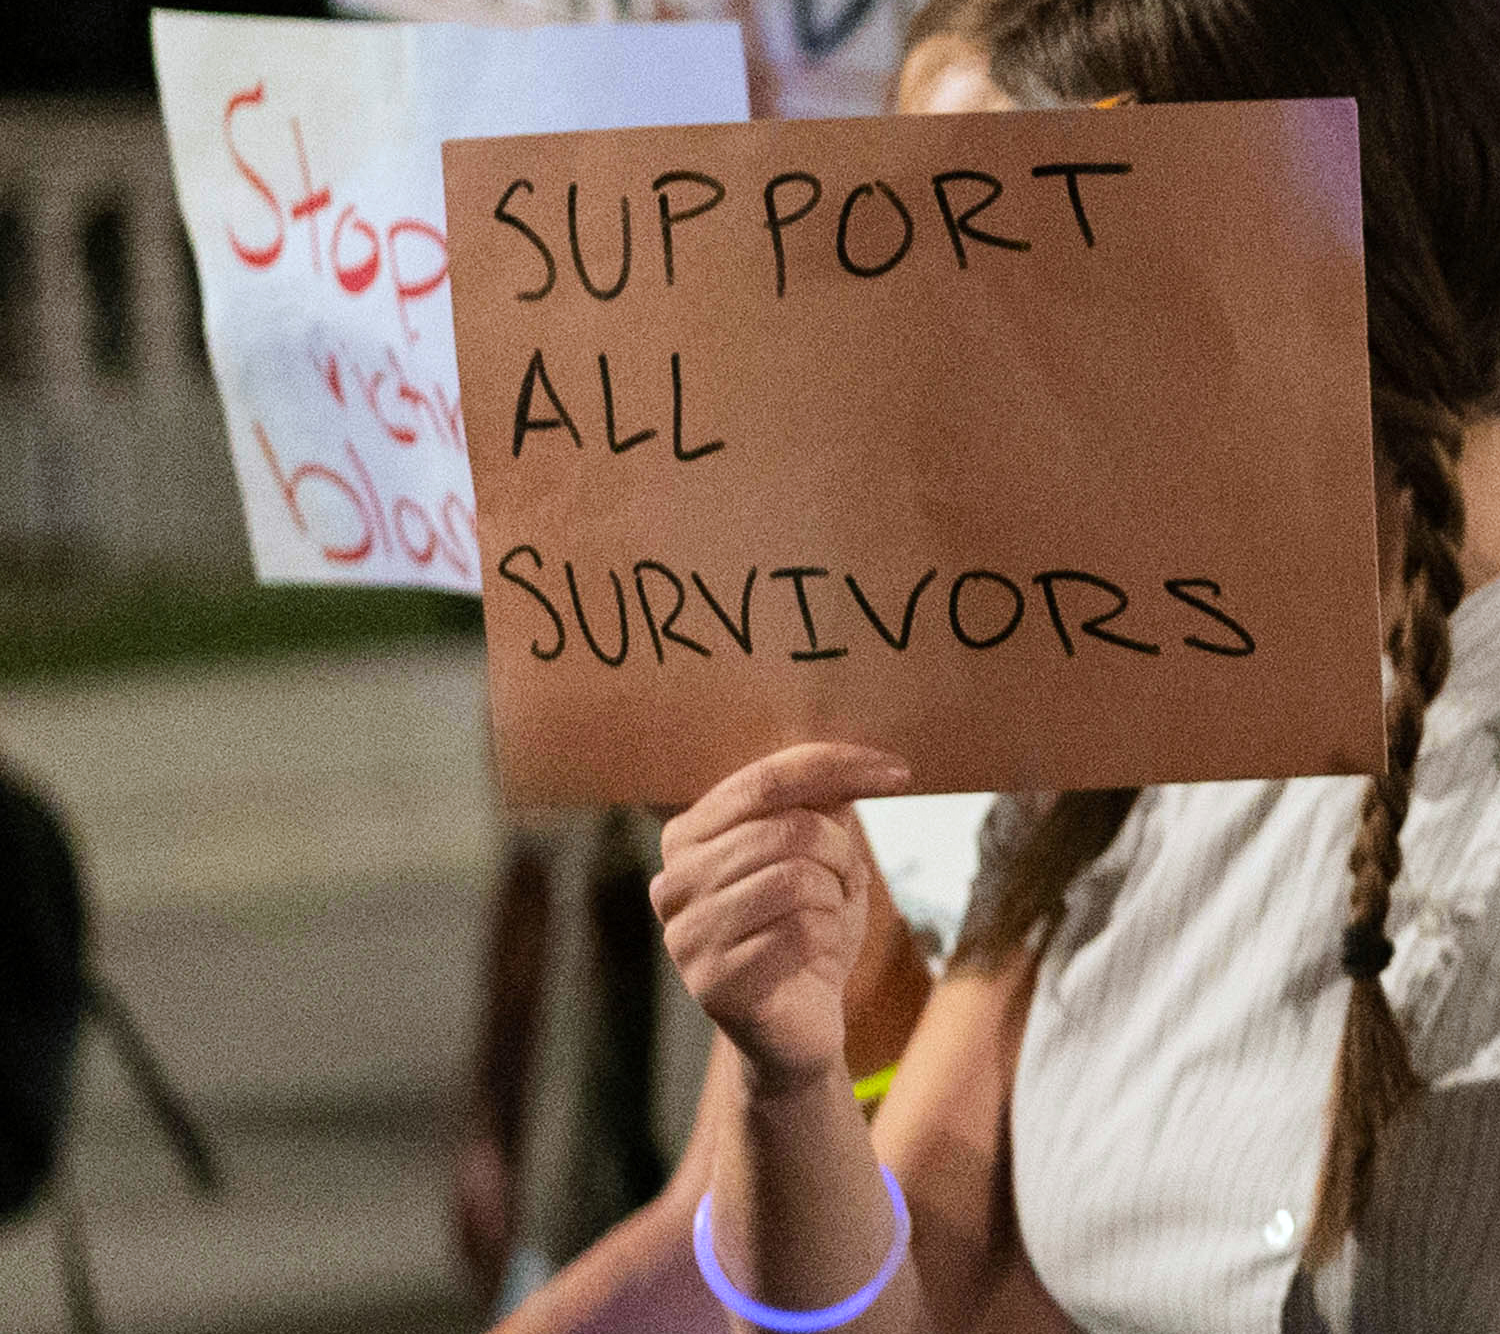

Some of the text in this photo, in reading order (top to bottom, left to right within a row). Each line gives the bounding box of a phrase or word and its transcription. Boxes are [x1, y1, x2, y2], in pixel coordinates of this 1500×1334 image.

[223, 82, 447, 344] Stop
[493, 163, 1133, 301] SUPPORT
[512, 348, 726, 463] ALL
[497, 542, 1256, 666] SURVIVORS
